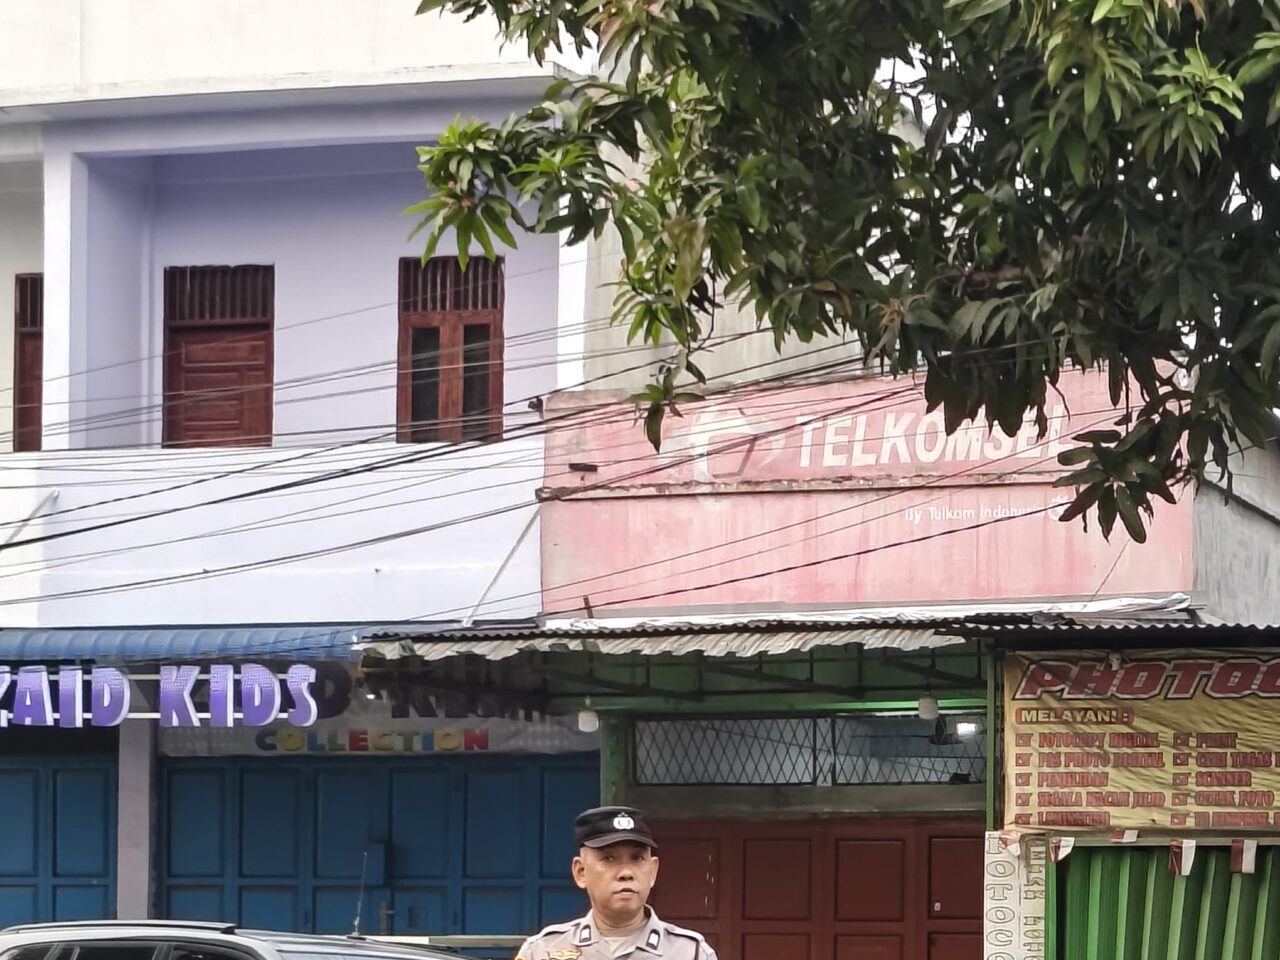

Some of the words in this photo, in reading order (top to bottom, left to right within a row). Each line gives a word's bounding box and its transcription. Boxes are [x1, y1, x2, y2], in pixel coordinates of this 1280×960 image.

[799, 404, 1092, 468] TELKOMSEL
[159, 663, 317, 727] KIDS
[1021, 709, 1118, 723] MELAYANI
[255, 729, 490, 752] COLLECTION
